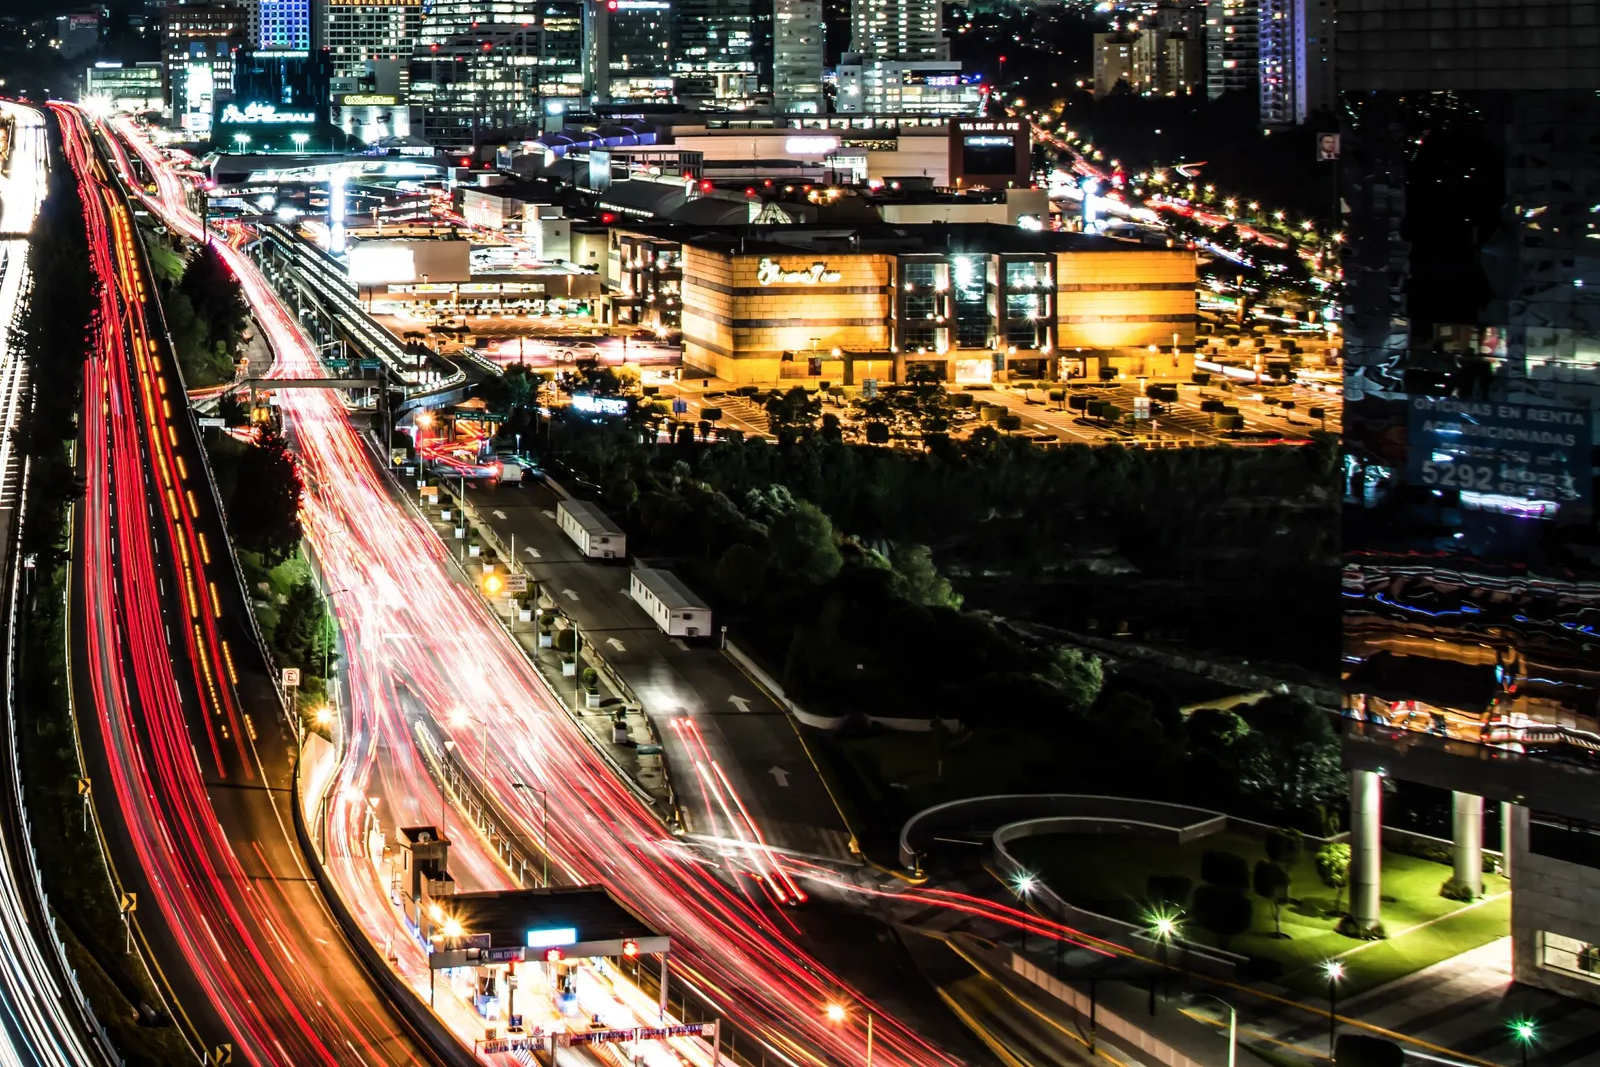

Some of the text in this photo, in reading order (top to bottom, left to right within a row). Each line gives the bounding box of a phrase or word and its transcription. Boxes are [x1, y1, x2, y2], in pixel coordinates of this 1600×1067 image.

[1413, 398, 1586, 426] OFICINAS EN RENTA
[1421, 460, 1495, 491] 5292
